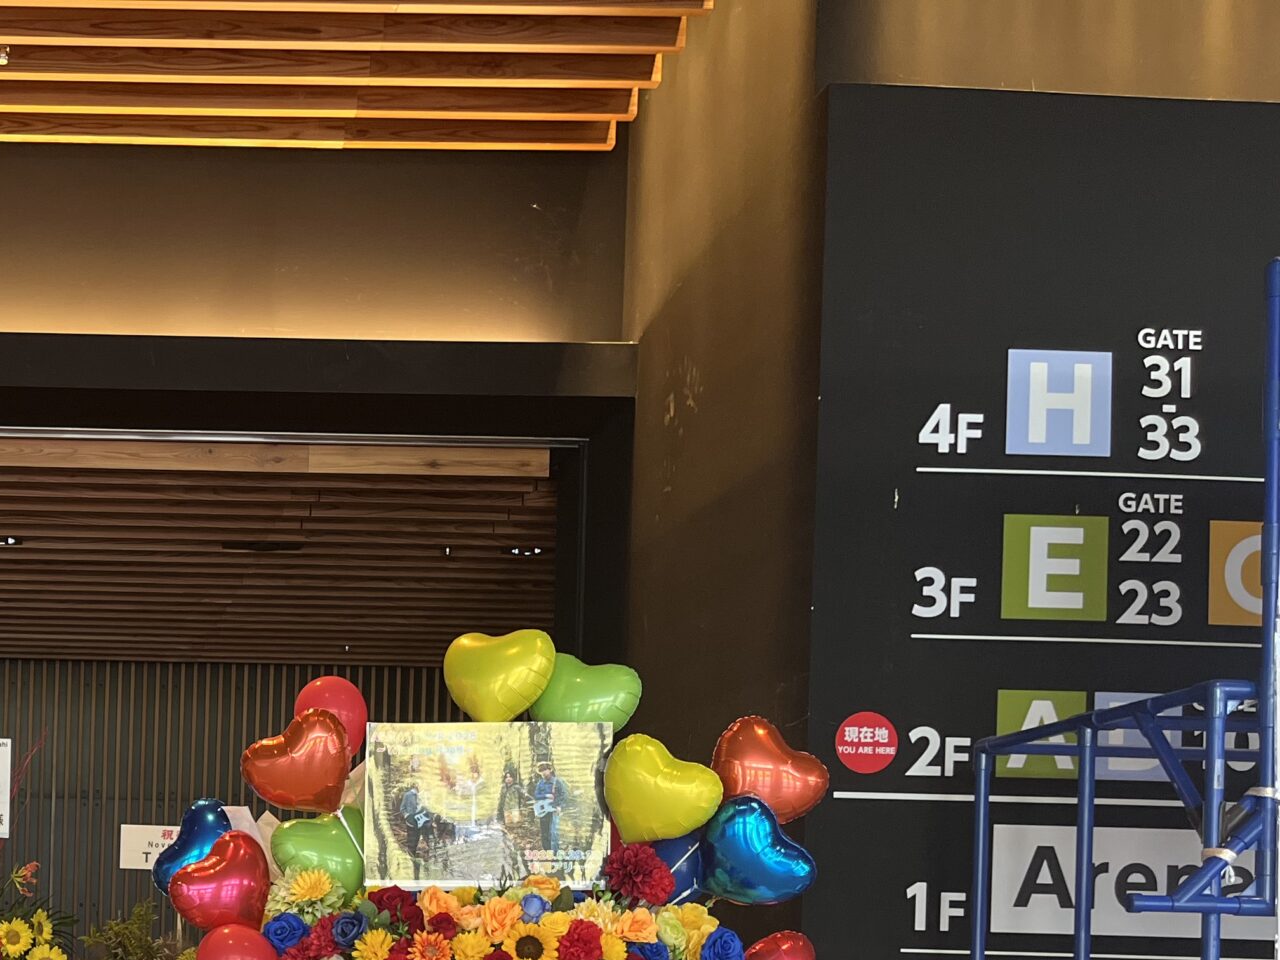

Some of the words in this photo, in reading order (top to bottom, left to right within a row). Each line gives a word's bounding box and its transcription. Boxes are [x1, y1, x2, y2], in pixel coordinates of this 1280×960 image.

[1137, 328, 1202, 350] GATE
[1141, 356, 1191, 398] 31
[919, 403, 984, 454] 4F
[1028, 362, 1092, 445] H
[1137, 416, 1201, 461] 33
[1118, 492, 1183, 515] GATE
[1118, 520, 1182, 563] 22
[911, 566, 977, 618] 3F
[1027, 526, 1084, 609] E
[1116, 580, 1182, 626] 23
[837, 745, 857, 755] YOU
[858, 746, 876, 755] ARE
[877, 746, 896, 755] HERE
[843, 727, 888, 744] 現在地
[905, 726, 971, 777] 2F
[905, 881, 967, 932] 1F
